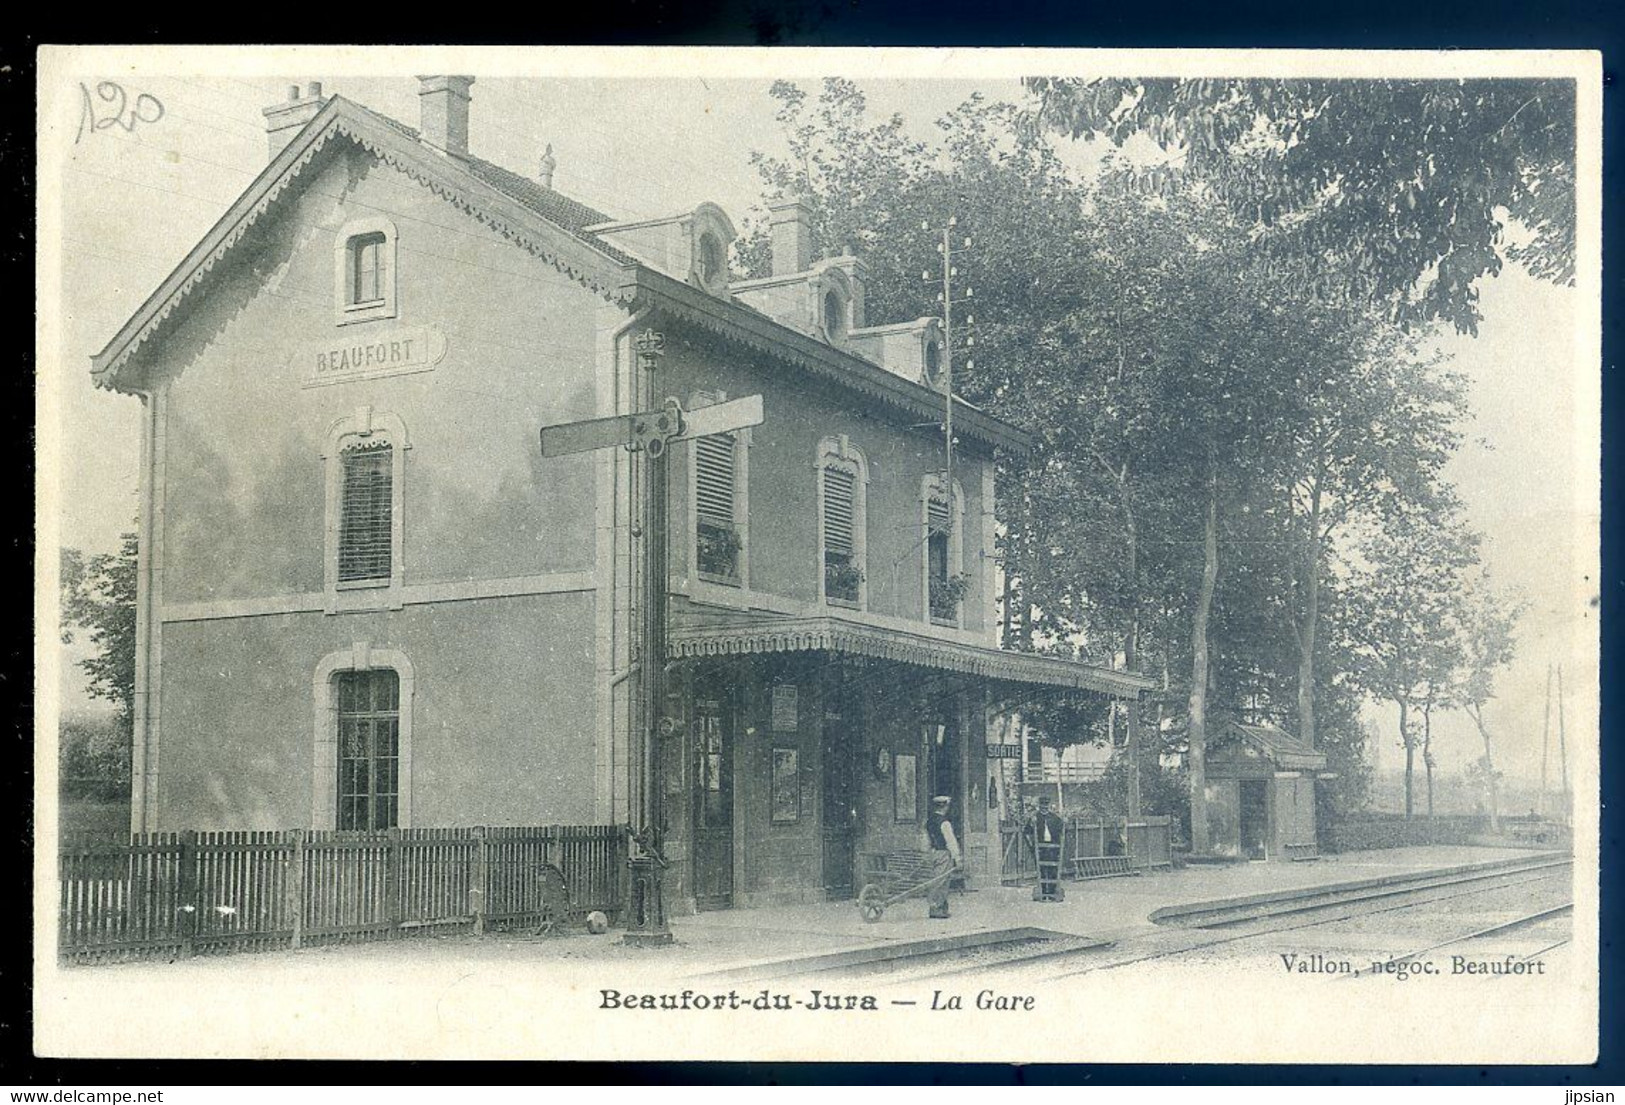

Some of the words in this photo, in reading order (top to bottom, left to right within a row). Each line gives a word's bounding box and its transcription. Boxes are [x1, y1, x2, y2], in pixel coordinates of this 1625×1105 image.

[75, 81, 165, 144] 120
[317, 339, 414, 372] BEAUFORT
[987, 745, 1021, 758] SORTIE
